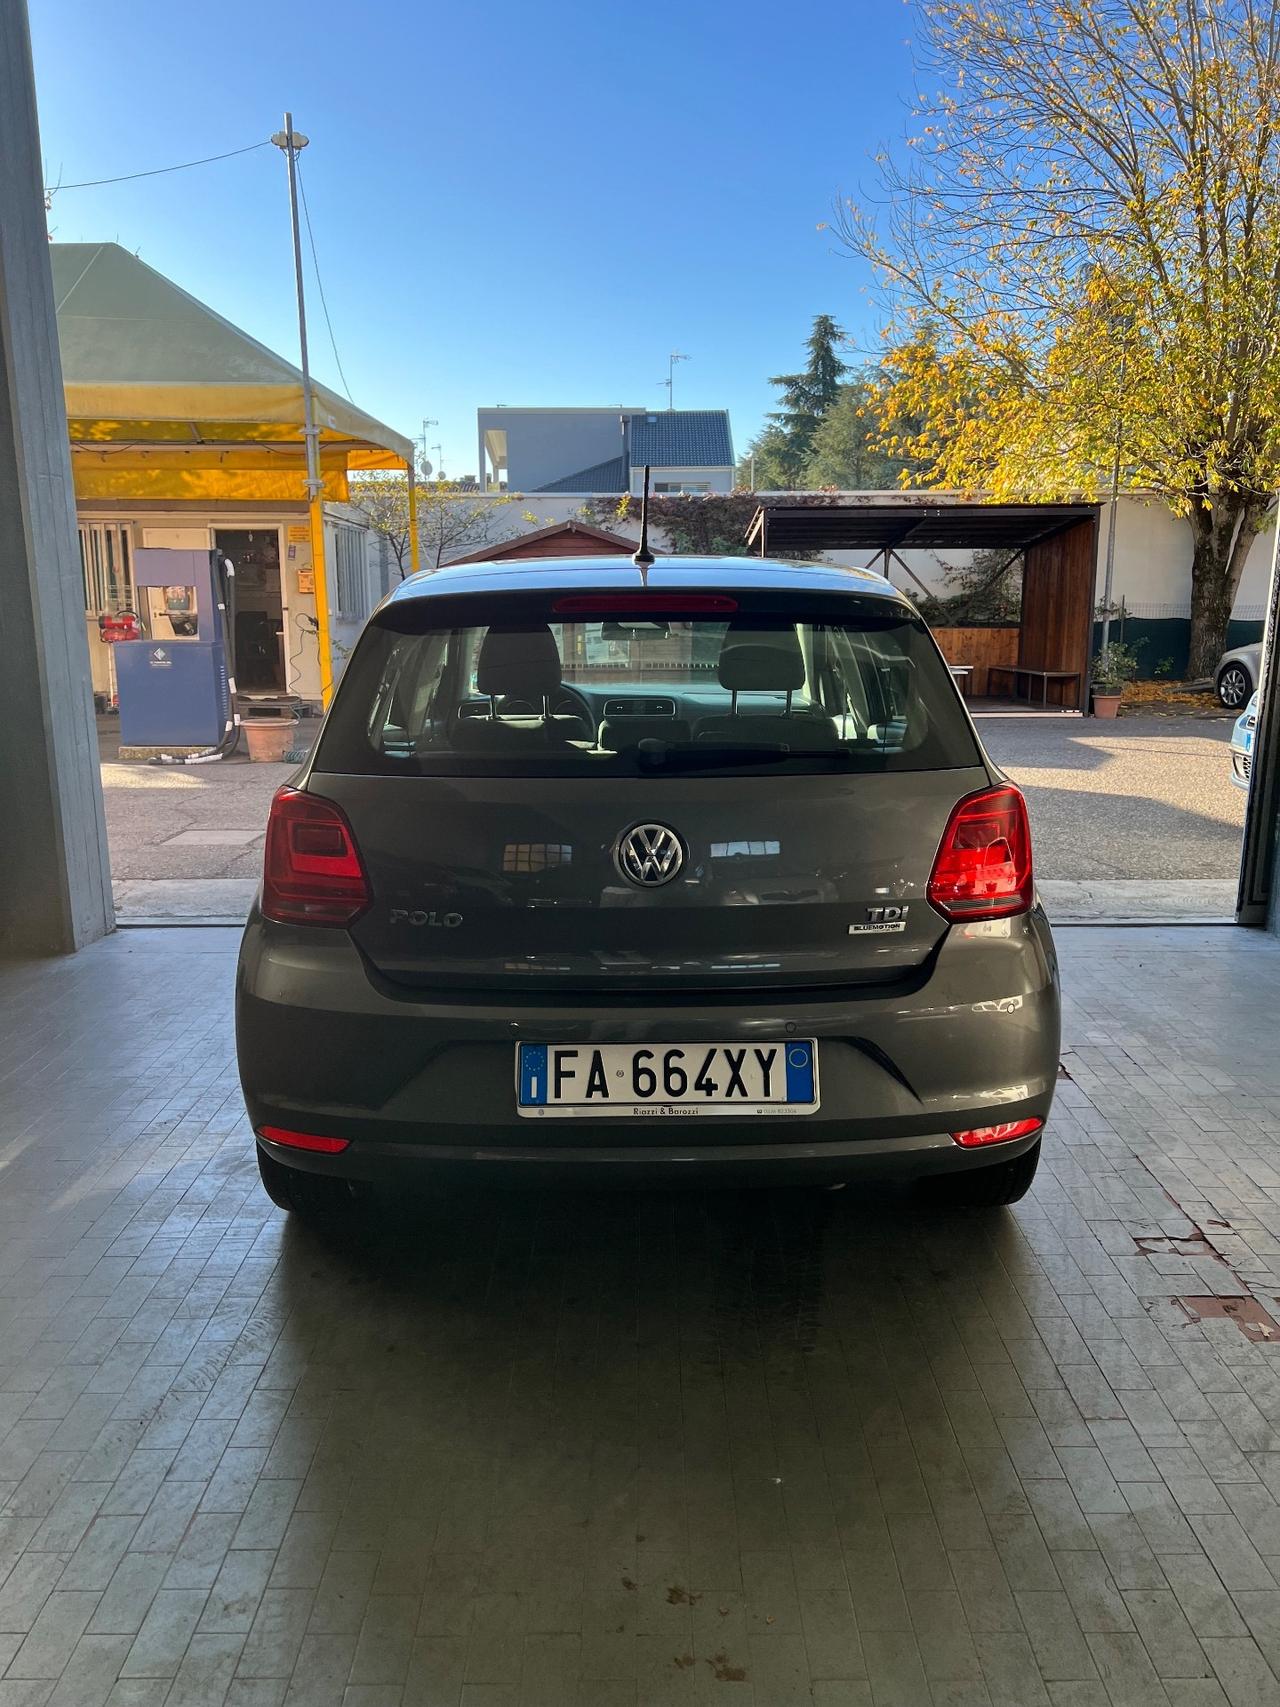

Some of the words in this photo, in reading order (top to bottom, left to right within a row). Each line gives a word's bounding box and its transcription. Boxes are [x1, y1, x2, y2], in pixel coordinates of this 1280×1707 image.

[390, 908, 463, 928] POLO
[867, 905, 909, 921] TDI
[659, 1107, 666, 1115] &
